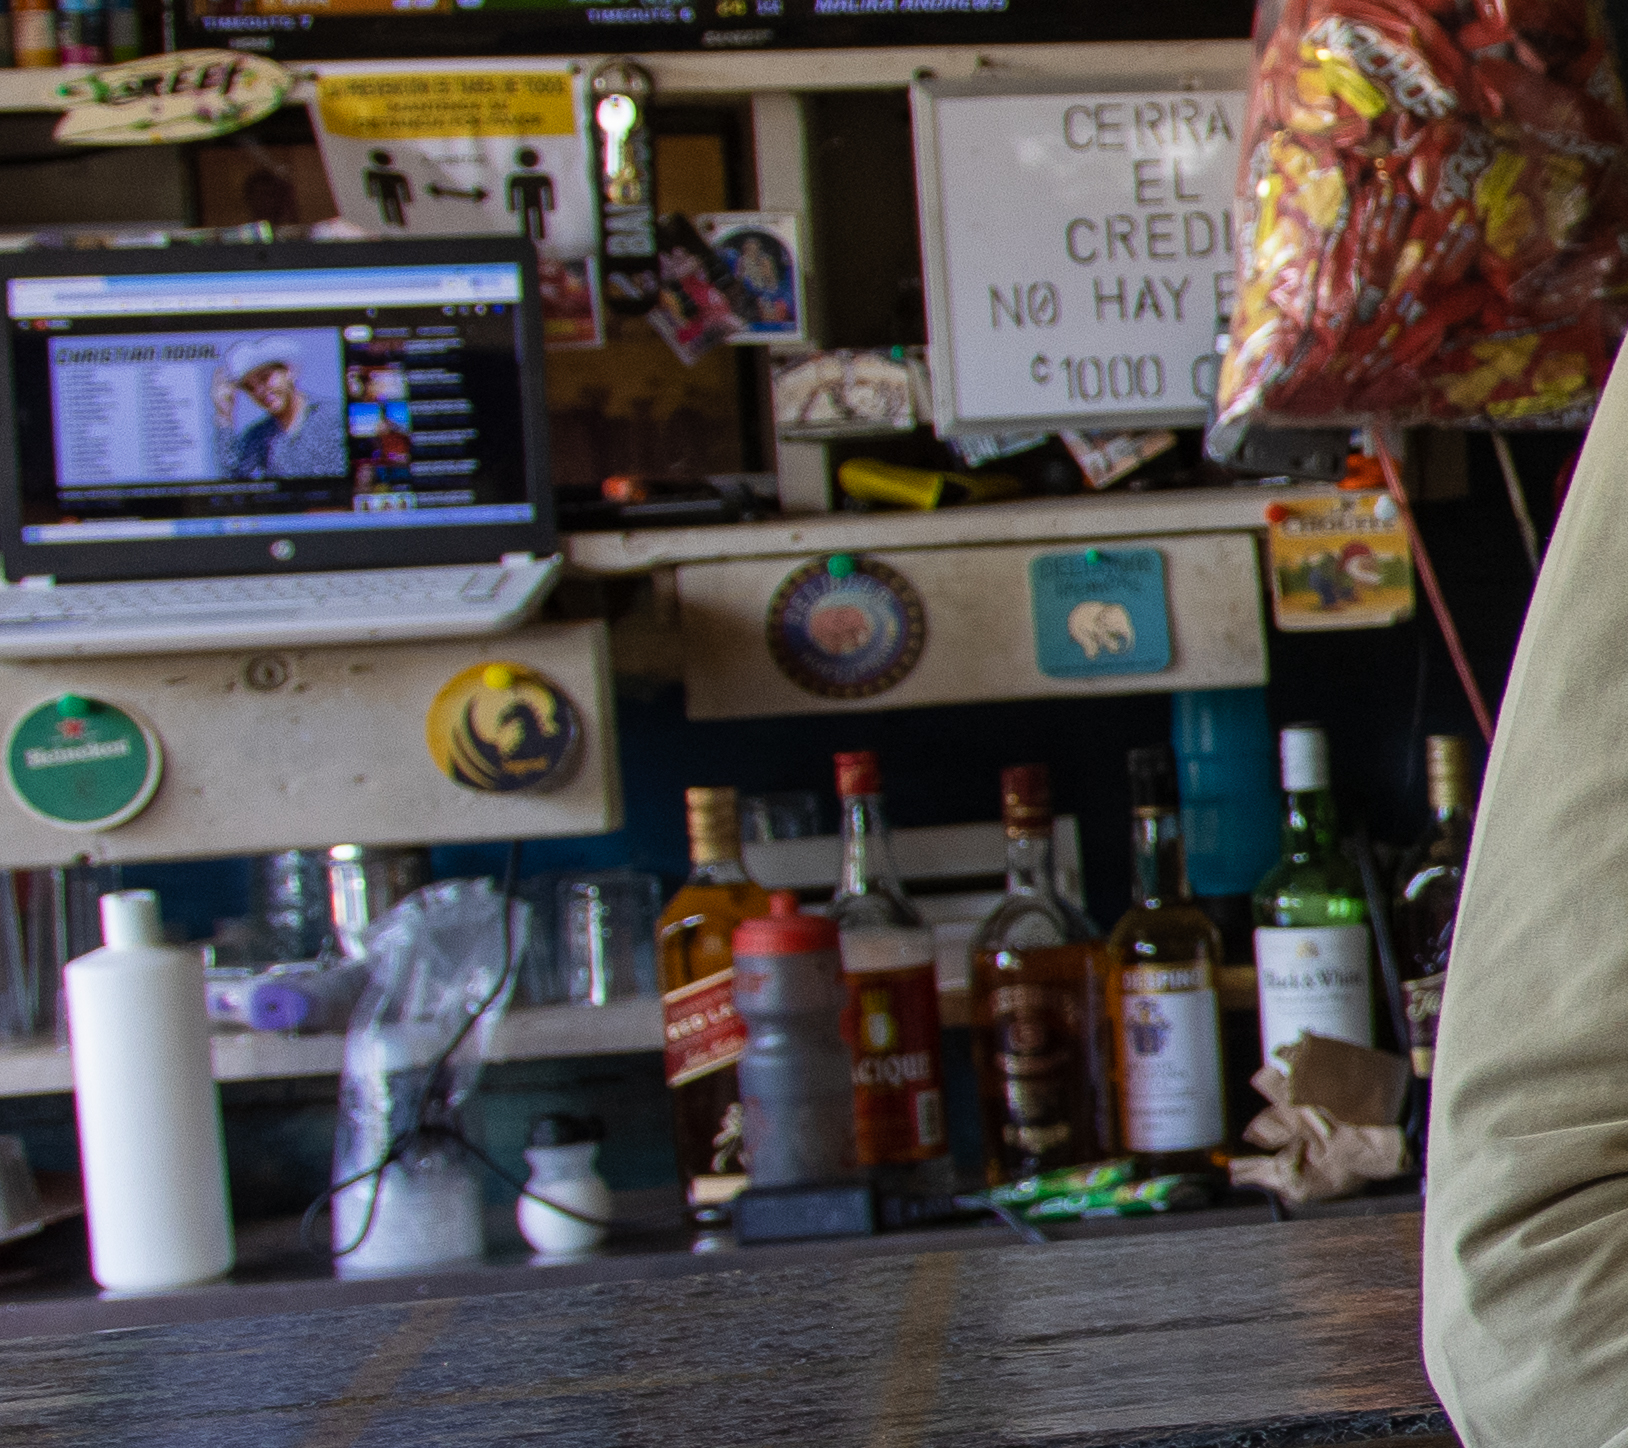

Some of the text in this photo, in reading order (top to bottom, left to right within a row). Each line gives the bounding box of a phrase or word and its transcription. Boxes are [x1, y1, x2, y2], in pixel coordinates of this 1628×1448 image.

[1062, 98, 1235, 152] CERRA
[1132, 156, 1201, 207] EL
[1064, 208, 1235, 265] CREDI
[1091, 274, 1191, 323] HAY
[23, 737, 131, 770] Heineken
